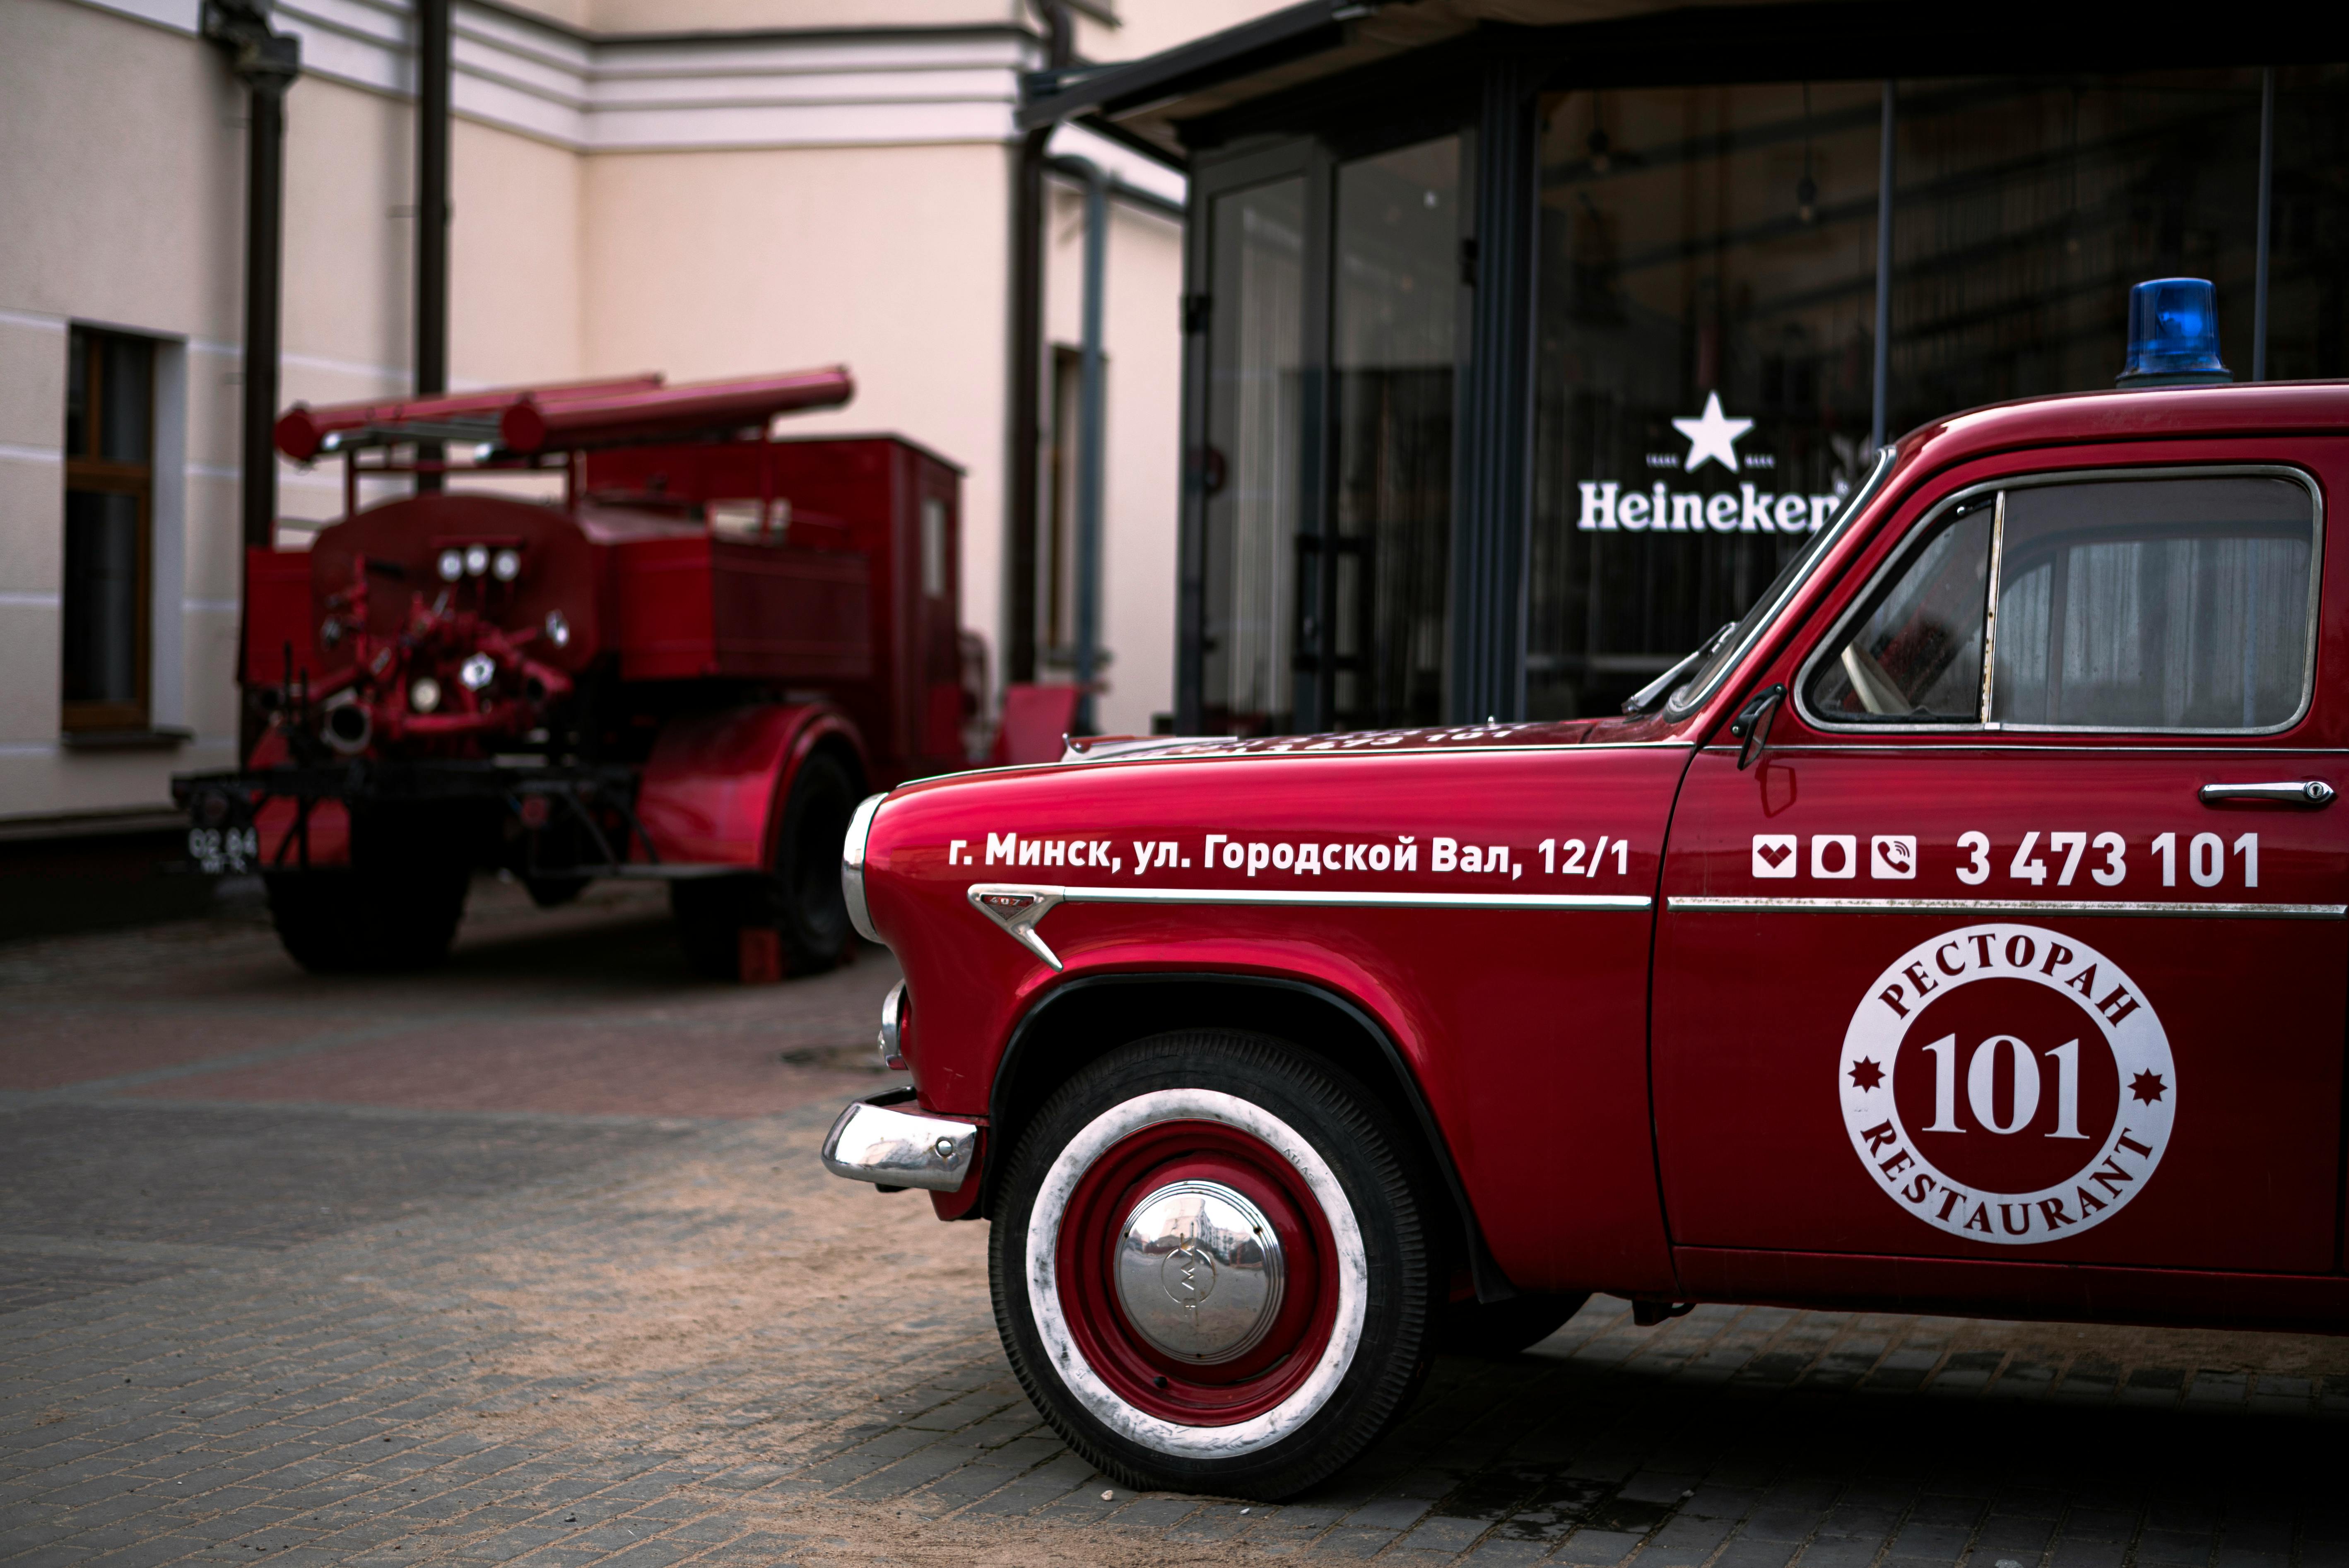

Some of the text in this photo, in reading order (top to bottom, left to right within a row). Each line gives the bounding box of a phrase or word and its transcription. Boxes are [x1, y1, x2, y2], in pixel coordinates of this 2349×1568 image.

[1578, 481, 1840, 532] Heineken
[1425, 730, 1514, 742] 101
[949, 832, 1628, 880] г. Минск, ул. Городской Вал, 12/1
[1956, 831, 2257, 887] 3 473 101
[1877, 933, 2142, 1028] РЕСТОРАН
[1922, 1033, 2090, 1139] 101
[1860, 1117, 2153, 1235] RESTAURANT
